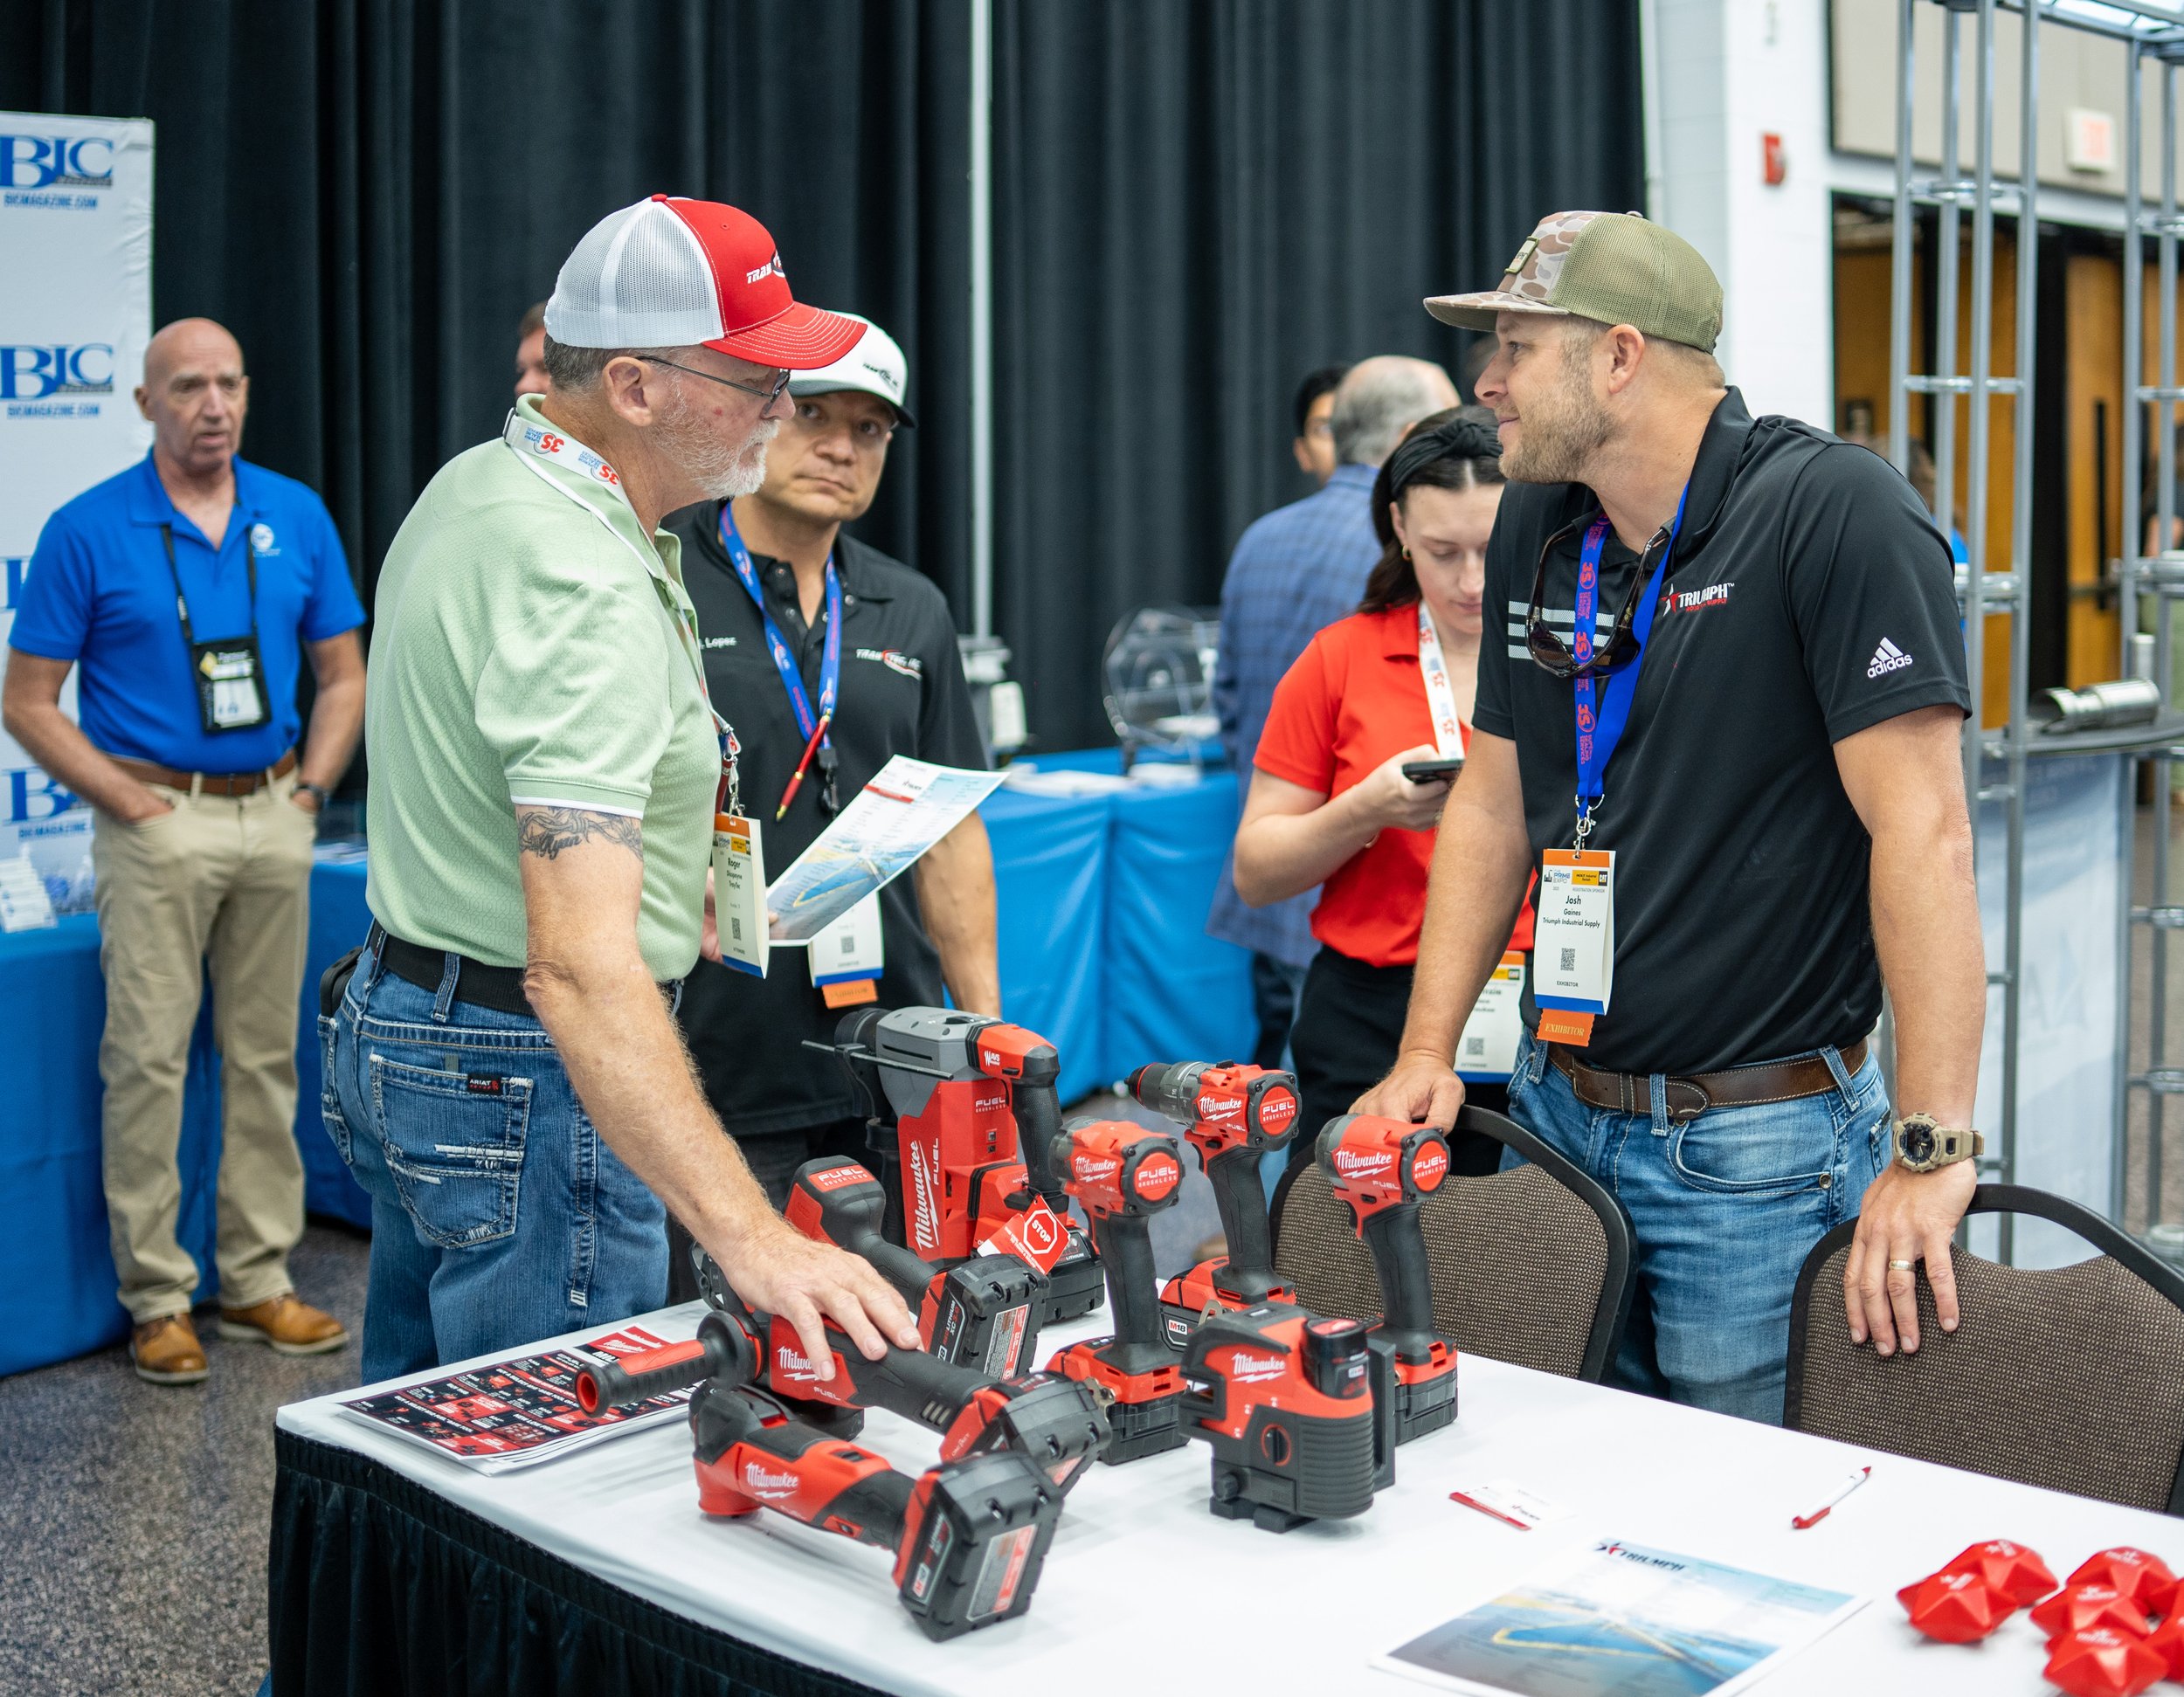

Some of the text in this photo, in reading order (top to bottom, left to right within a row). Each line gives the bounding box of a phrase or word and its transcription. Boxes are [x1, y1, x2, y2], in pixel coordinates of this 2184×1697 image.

[0, 135, 114, 189] BIC
[0, 343, 114, 401] BIC
[541, 434, 564, 452] 3S
[599, 465, 620, 485] 3S
[1868, 655, 1913, 678] adidas
[1577, 704, 1591, 726] 3S
[727, 858, 741, 870] Roger
[1565, 895, 1581, 904] Josh
[1584, 920, 1600, 928] Supply
[1545, 1023, 1585, 1037] EXHIBITOR
[975, 1097, 1006, 1107] FUEL
[1199, 1095, 1242, 1114] Milwaukee
[1262, 1100, 1295, 1114] FUEL
[1262, 1110, 1295, 1122] BRUSHLESS
[1226, 1122, 1246, 1131] FUEL
[1075, 1155, 1116, 1174] Milwaukee
[1335, 1149, 1393, 1169] Milwaukee
[1414, 1155, 1447, 1171] FUEL
[818, 1169, 863, 1182] FUEL
[1138, 1166, 1177, 1181] FUEL
[1414, 1165, 1447, 1179] BRUSHLESS
[824, 1174, 867, 1186] BRUSHLESS
[1138, 1176, 1178, 1188] BRUSHLESS
[1372, 1180, 1400, 1190] FUEL
[910, 1140, 934, 1251] Milwaukee
[1032, 1219, 1051, 1243] STOP
[1169, 1320, 1186, 1335] M18
[1232, 1353, 1286, 1375] Milwaukee
[813, 1386, 841, 1401] FUEL
[745, 1461, 798, 1487] Milwaukee
[1620, 1550, 1688, 1572] TRIUMPH
